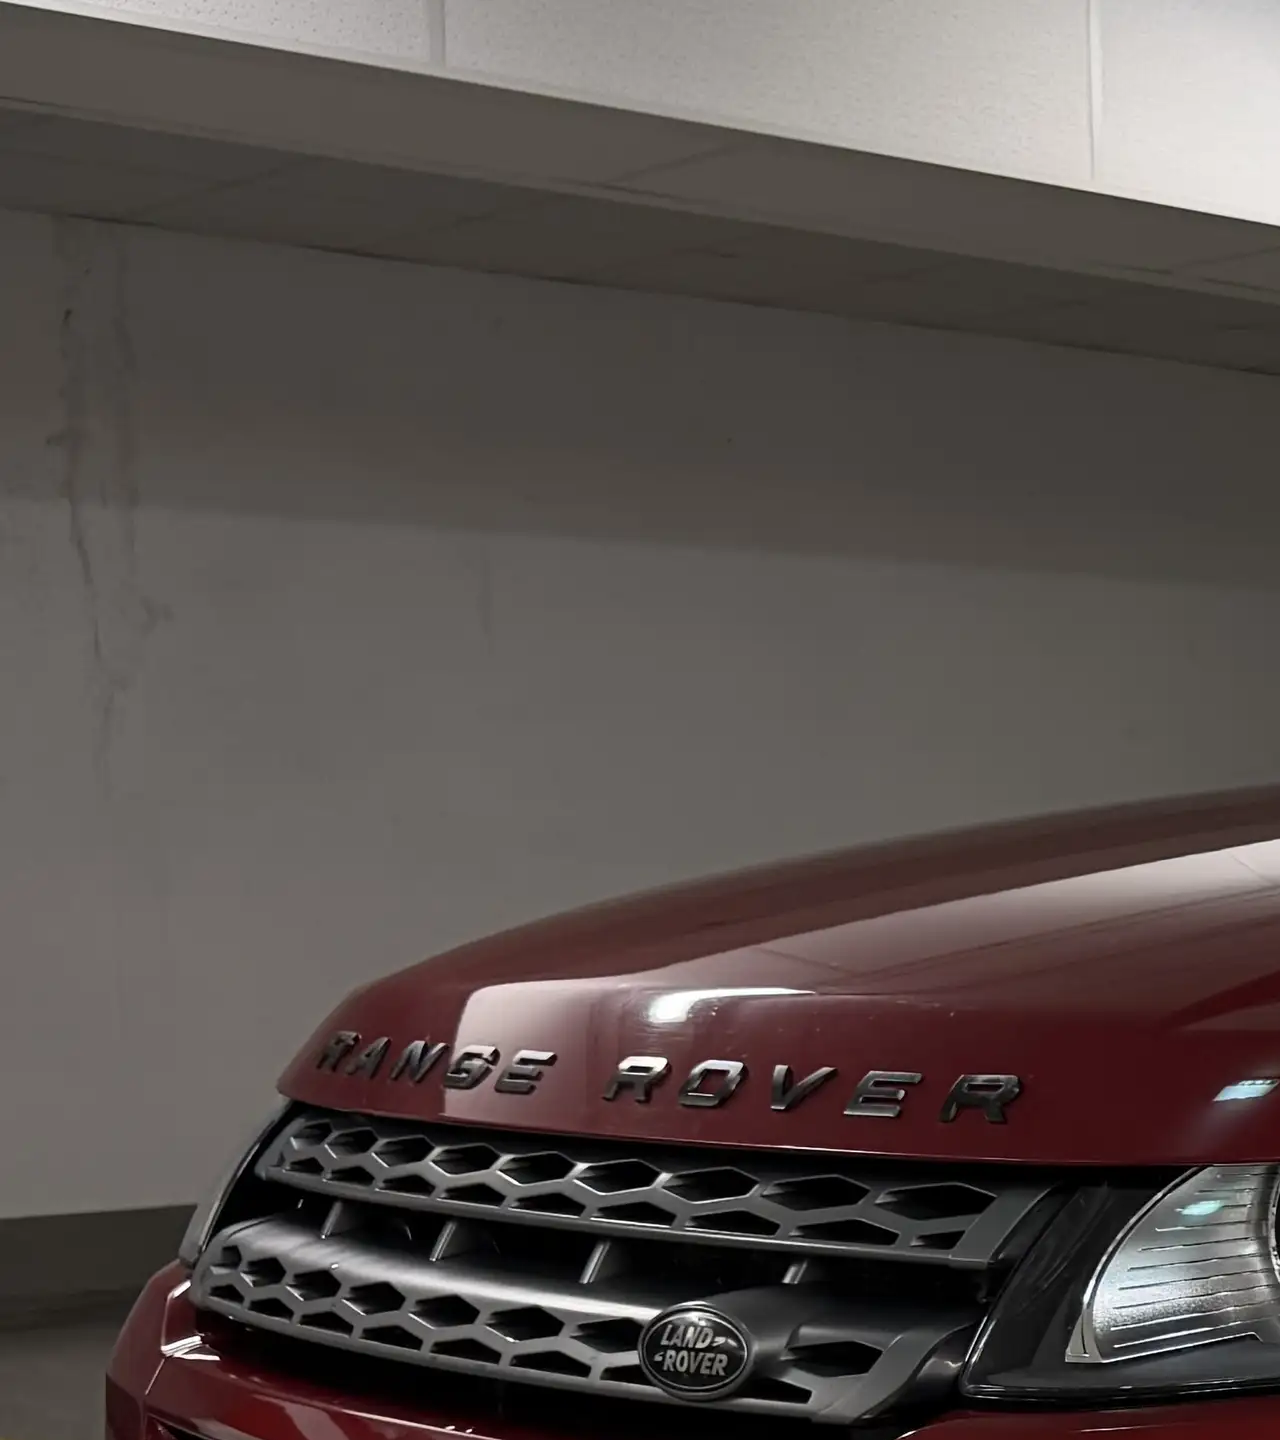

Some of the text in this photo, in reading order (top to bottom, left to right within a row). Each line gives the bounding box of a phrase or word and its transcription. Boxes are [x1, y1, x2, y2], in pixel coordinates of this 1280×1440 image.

[317, 1030, 1022, 1123] RANGE ROVER
[663, 1349, 728, 1376] ROVER
